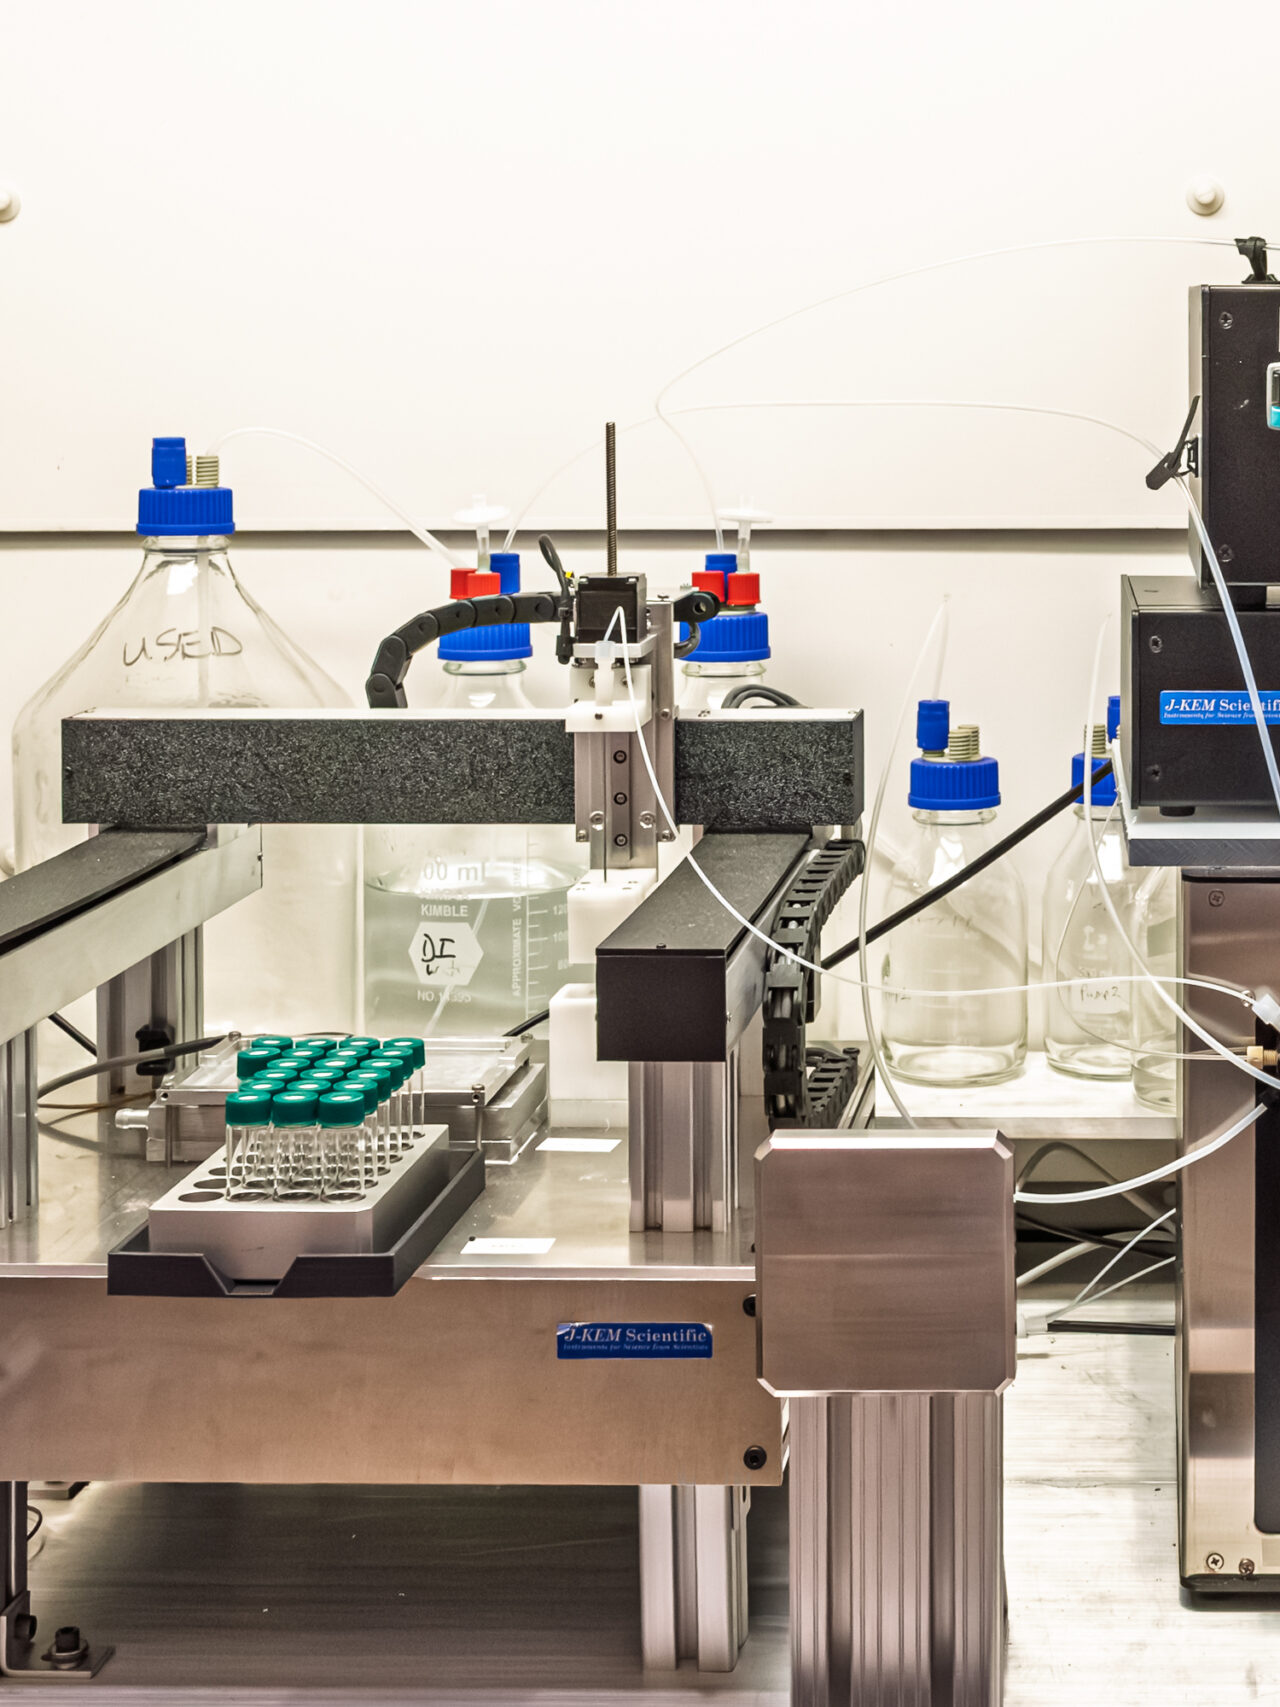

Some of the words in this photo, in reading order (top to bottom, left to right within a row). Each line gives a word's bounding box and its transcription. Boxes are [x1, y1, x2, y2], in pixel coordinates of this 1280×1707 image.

[122, 626, 243, 667] USED
[1164, 699, 1216, 711] J-KEM
[420, 904, 469, 917] KIMBLE
[563, 1328, 622, 1342] J-KEM
[625, 1328, 707, 1342] Scientific
